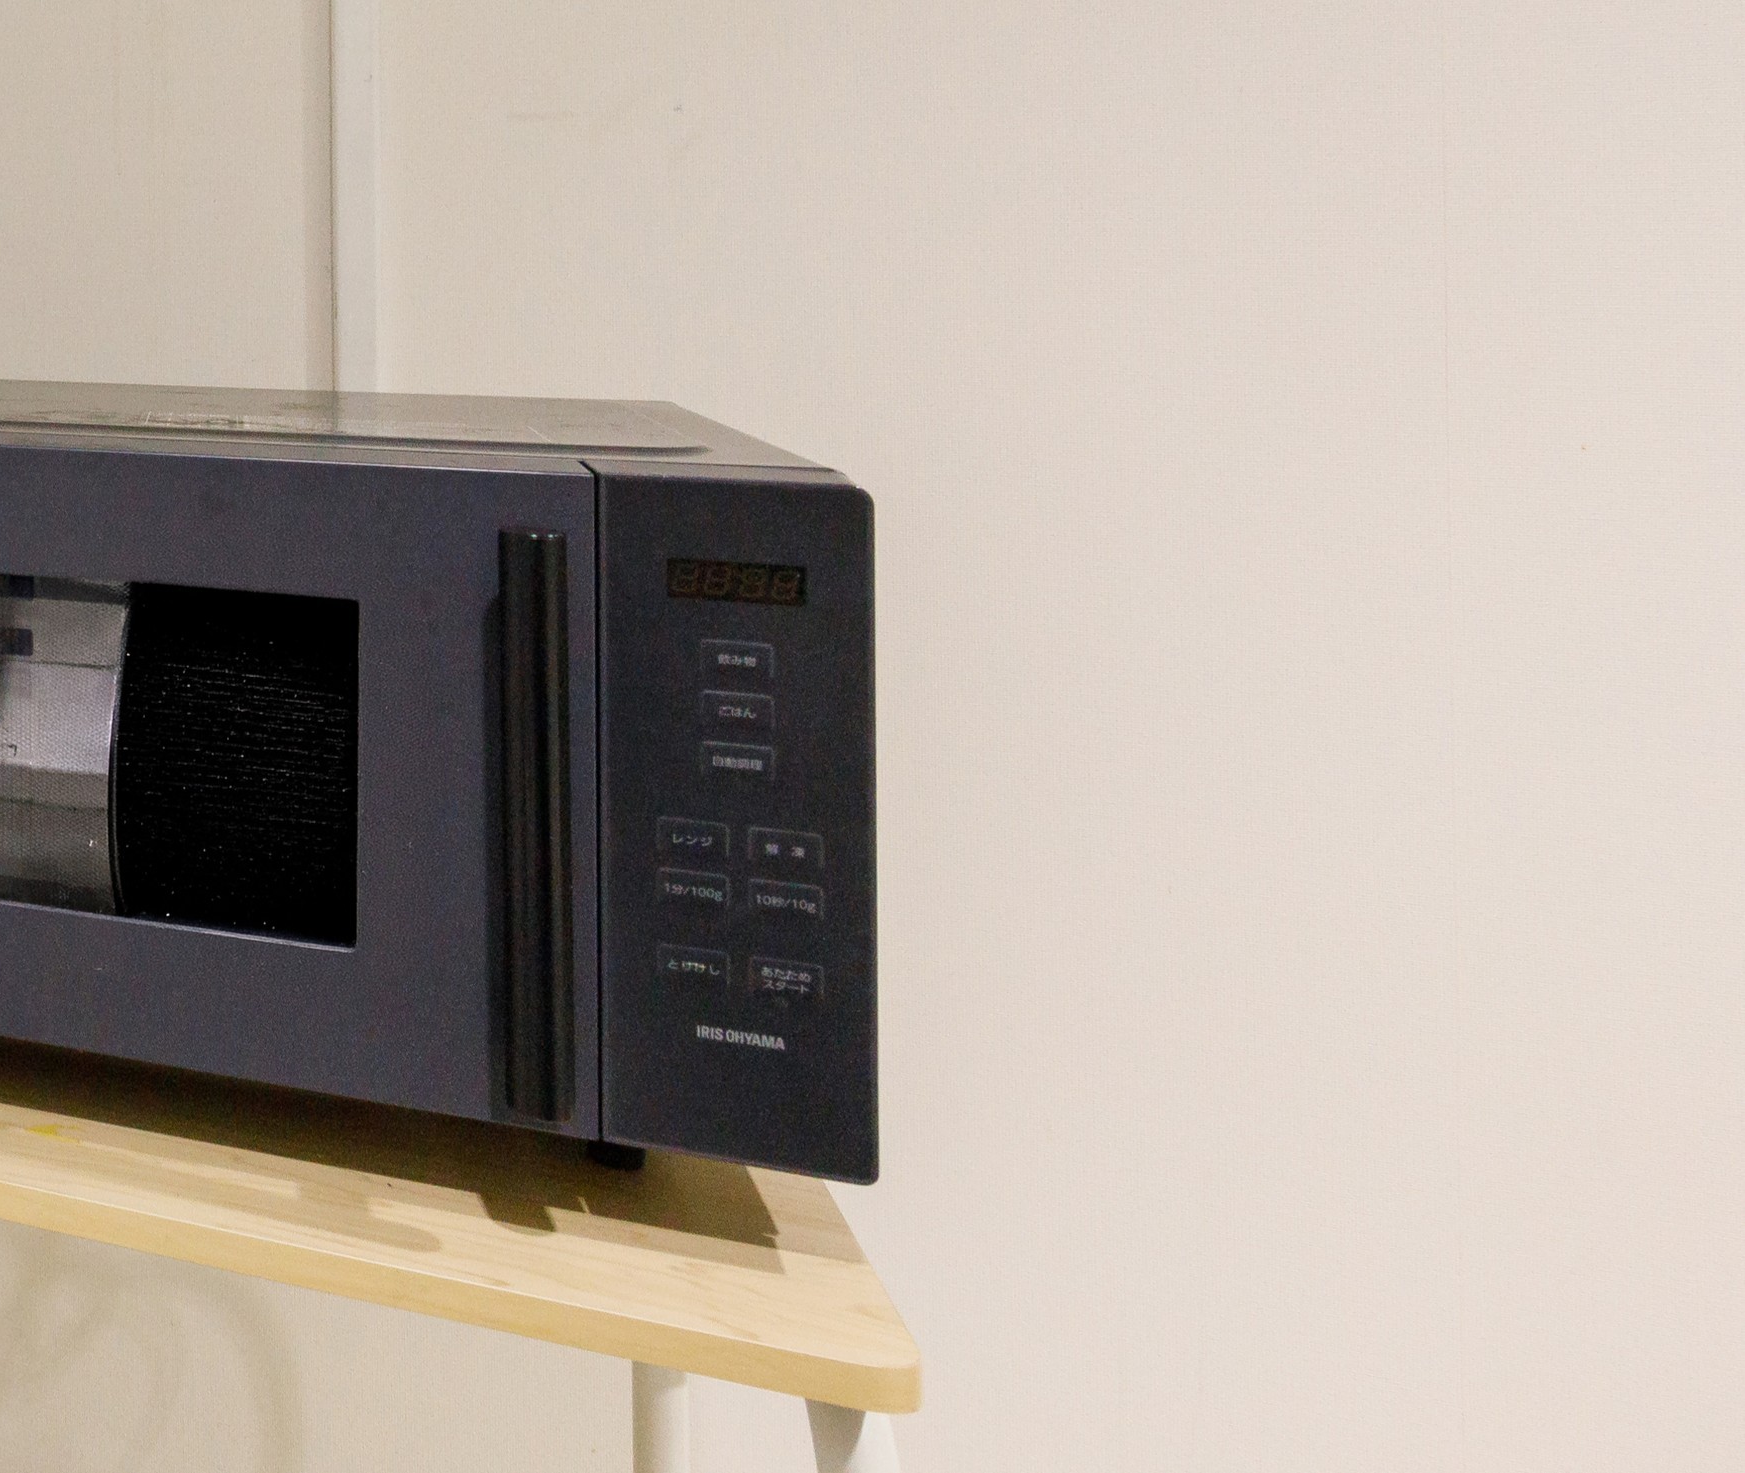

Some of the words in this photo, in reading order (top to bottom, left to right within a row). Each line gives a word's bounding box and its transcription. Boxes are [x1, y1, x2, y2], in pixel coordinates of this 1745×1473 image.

[718, 705, 757, 719] ごはん
[672, 833, 713, 846] レンジ
[667, 958, 720, 976] とりけし
[761, 966, 812, 983] あたため
[763, 979, 811, 994] スタート
[696, 1024, 724, 1042] IRIS
[726, 1028, 786, 1051] OHYAMA
